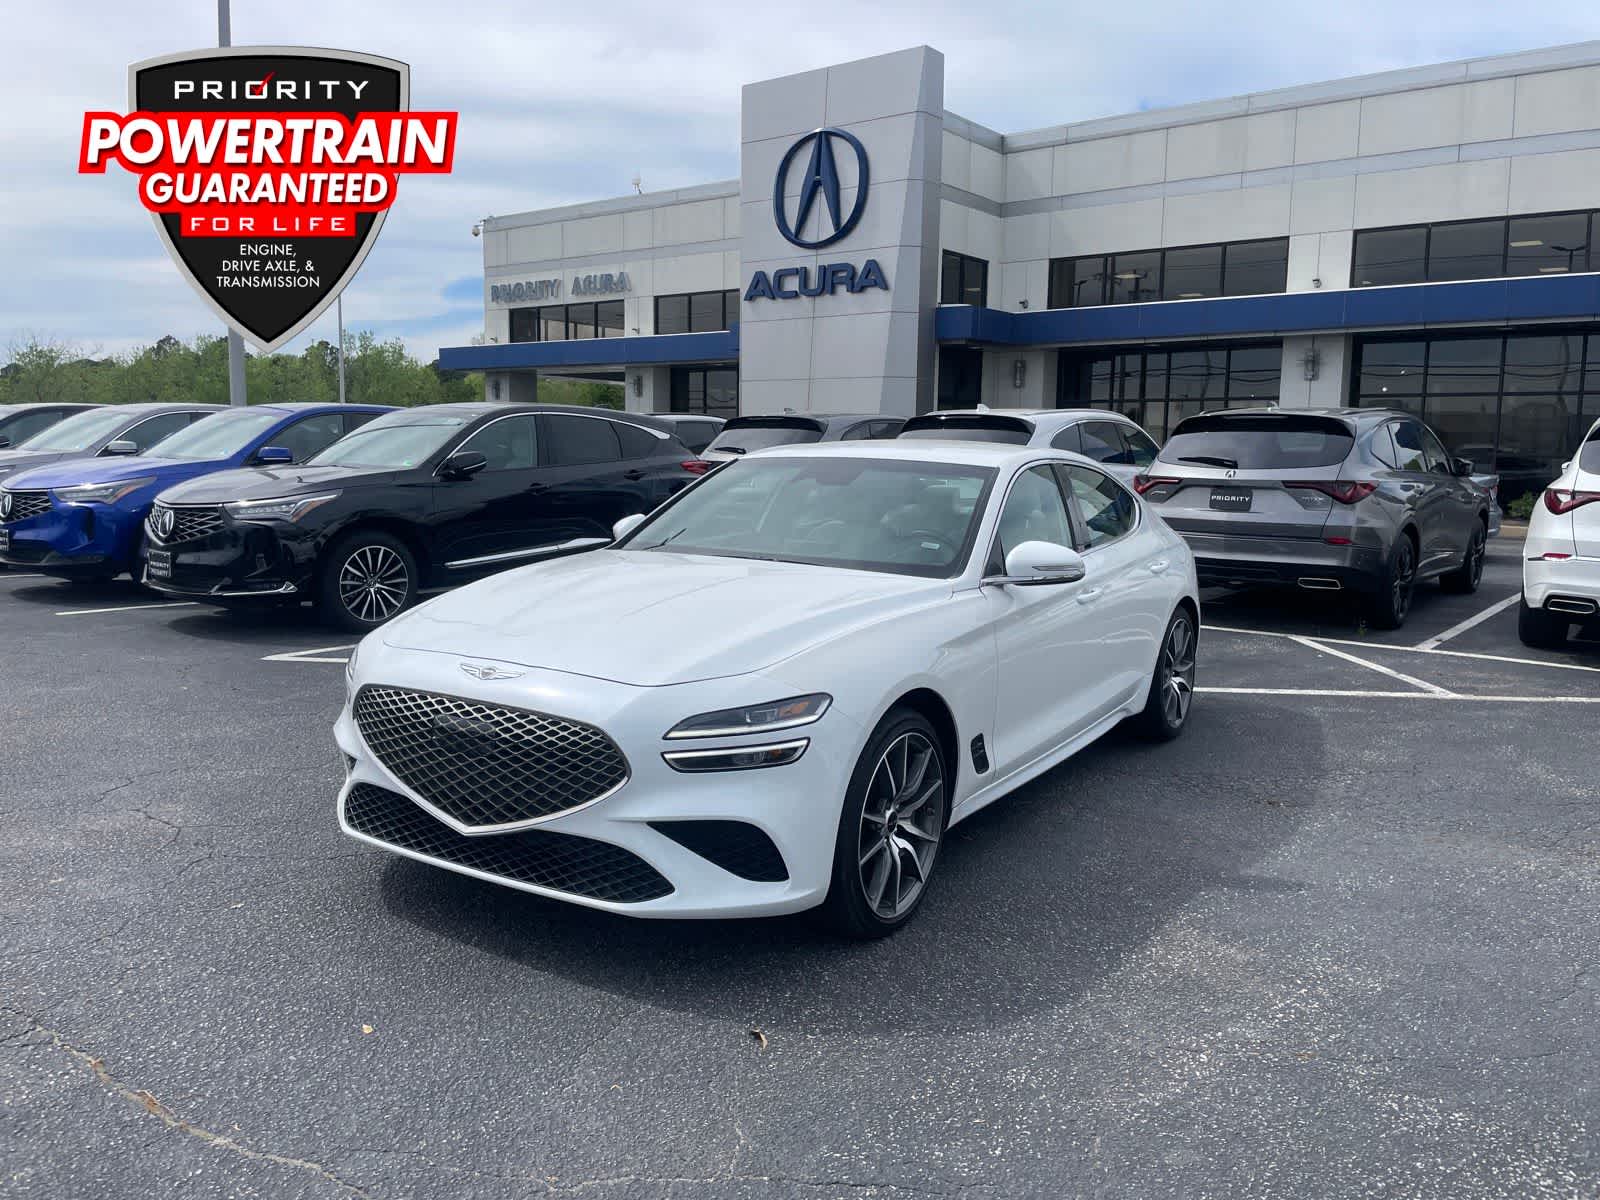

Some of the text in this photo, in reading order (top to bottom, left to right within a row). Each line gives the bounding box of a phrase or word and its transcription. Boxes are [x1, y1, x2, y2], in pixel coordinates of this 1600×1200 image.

[490, 271, 632, 303] PRIORITY ACURA
[743, 259, 889, 301] ACURA
